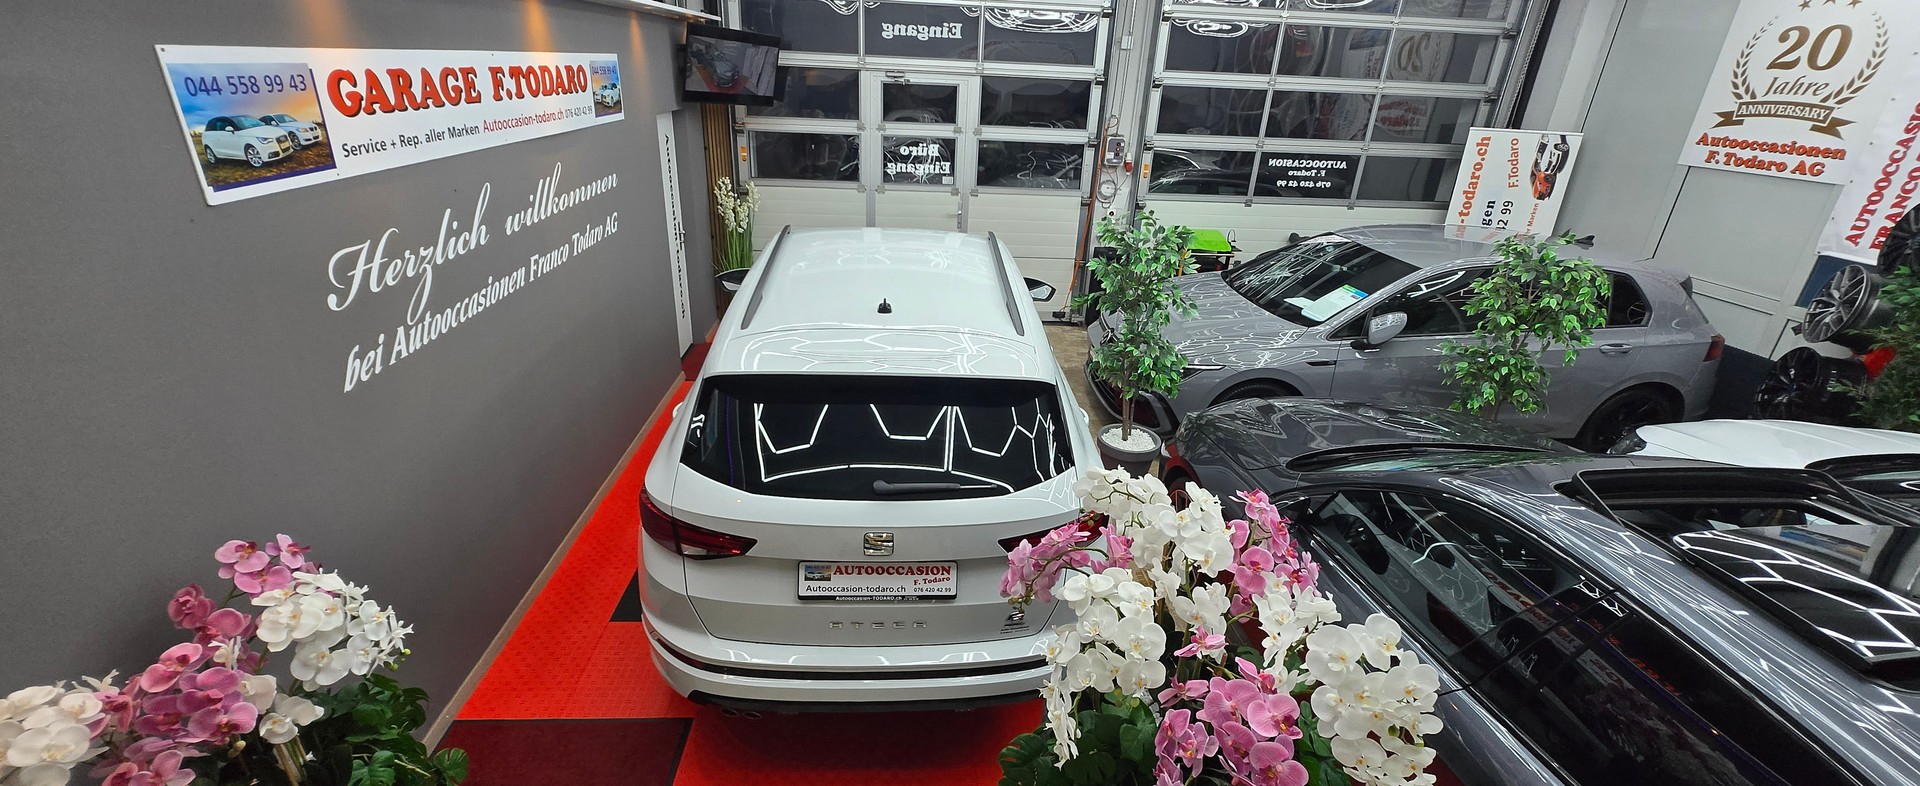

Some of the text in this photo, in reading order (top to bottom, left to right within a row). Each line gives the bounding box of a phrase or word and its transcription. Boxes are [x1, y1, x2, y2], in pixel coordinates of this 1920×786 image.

[1766, 24, 1853, 71] 20
[184, 73, 308, 97] 044 558 99 43
[326, 64, 588, 118] GARAGE F.TODARO
[1762, 75, 1830, 97] Jahre
[1737, 104, 1830, 120] ANNIVERSARY
[342, 105, 593, 158] Service + Rep. aller Marken Autooccasion-todaro.ch 076 420 42 99
[1695, 132, 1847, 160] Autooccasionen
[1705, 150, 1825, 177] F. Todaro AG
[1501, 200, 1514, 216] 99
[327, 162, 618, 325] Herzlich willkommen
[343, 211, 619, 393] bei Autooccasionen Franco Todaro AG
[833, 565, 952, 576] AUTOOCCASION
[913, 576, 951, 586] F. Todaro
[805, 584, 906, 593] Autooccasion-todaro.ch
[829, 621, 927, 630] ATECA
